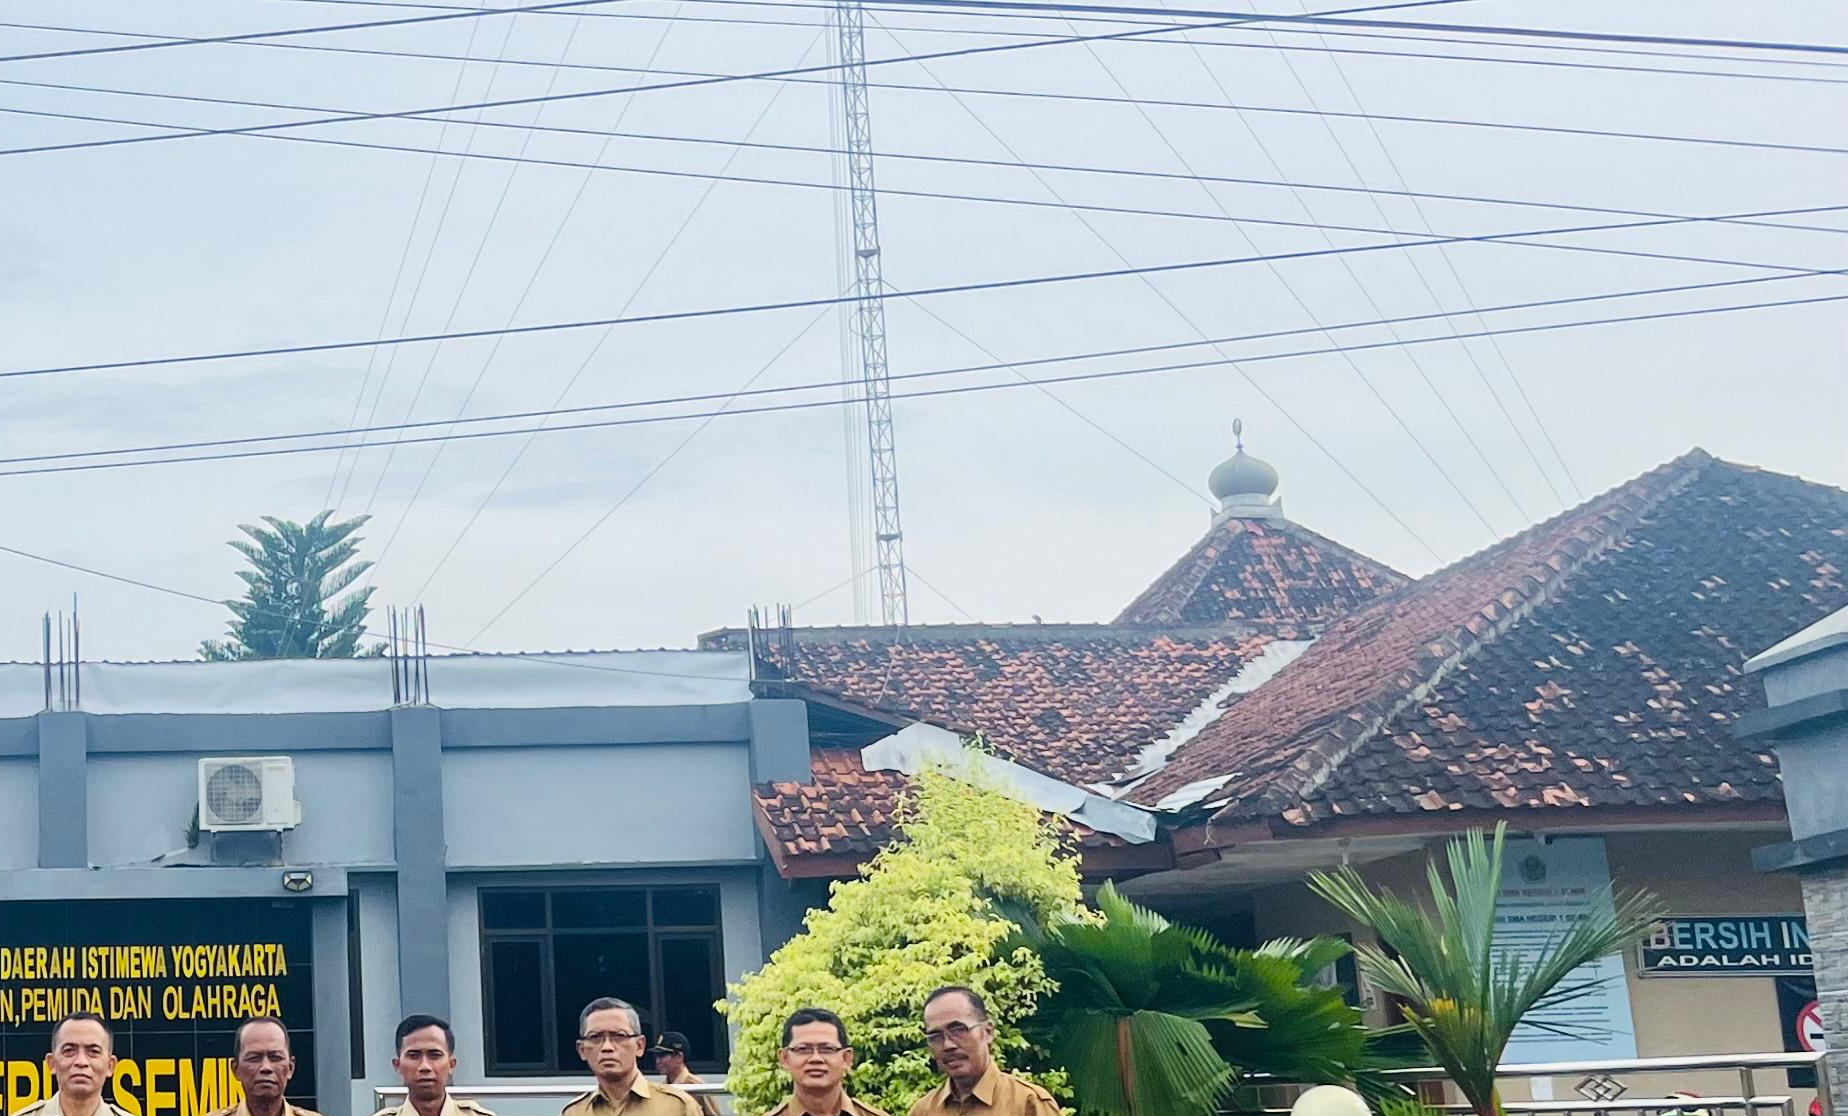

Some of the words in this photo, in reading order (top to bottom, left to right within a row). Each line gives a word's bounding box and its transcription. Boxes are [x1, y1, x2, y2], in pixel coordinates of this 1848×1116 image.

[1649, 920, 1772, 950] BERSIH
[0, 946, 75, 980] DAERAH
[81, 945, 167, 979] ISTIMEWA
[170, 943, 288, 978] YOGYAKARTA
[1656, 953, 1780, 967] ADALAH
[109, 985, 152, 1020] DAN
[162, 982, 282, 1020] OLAHRAGA
